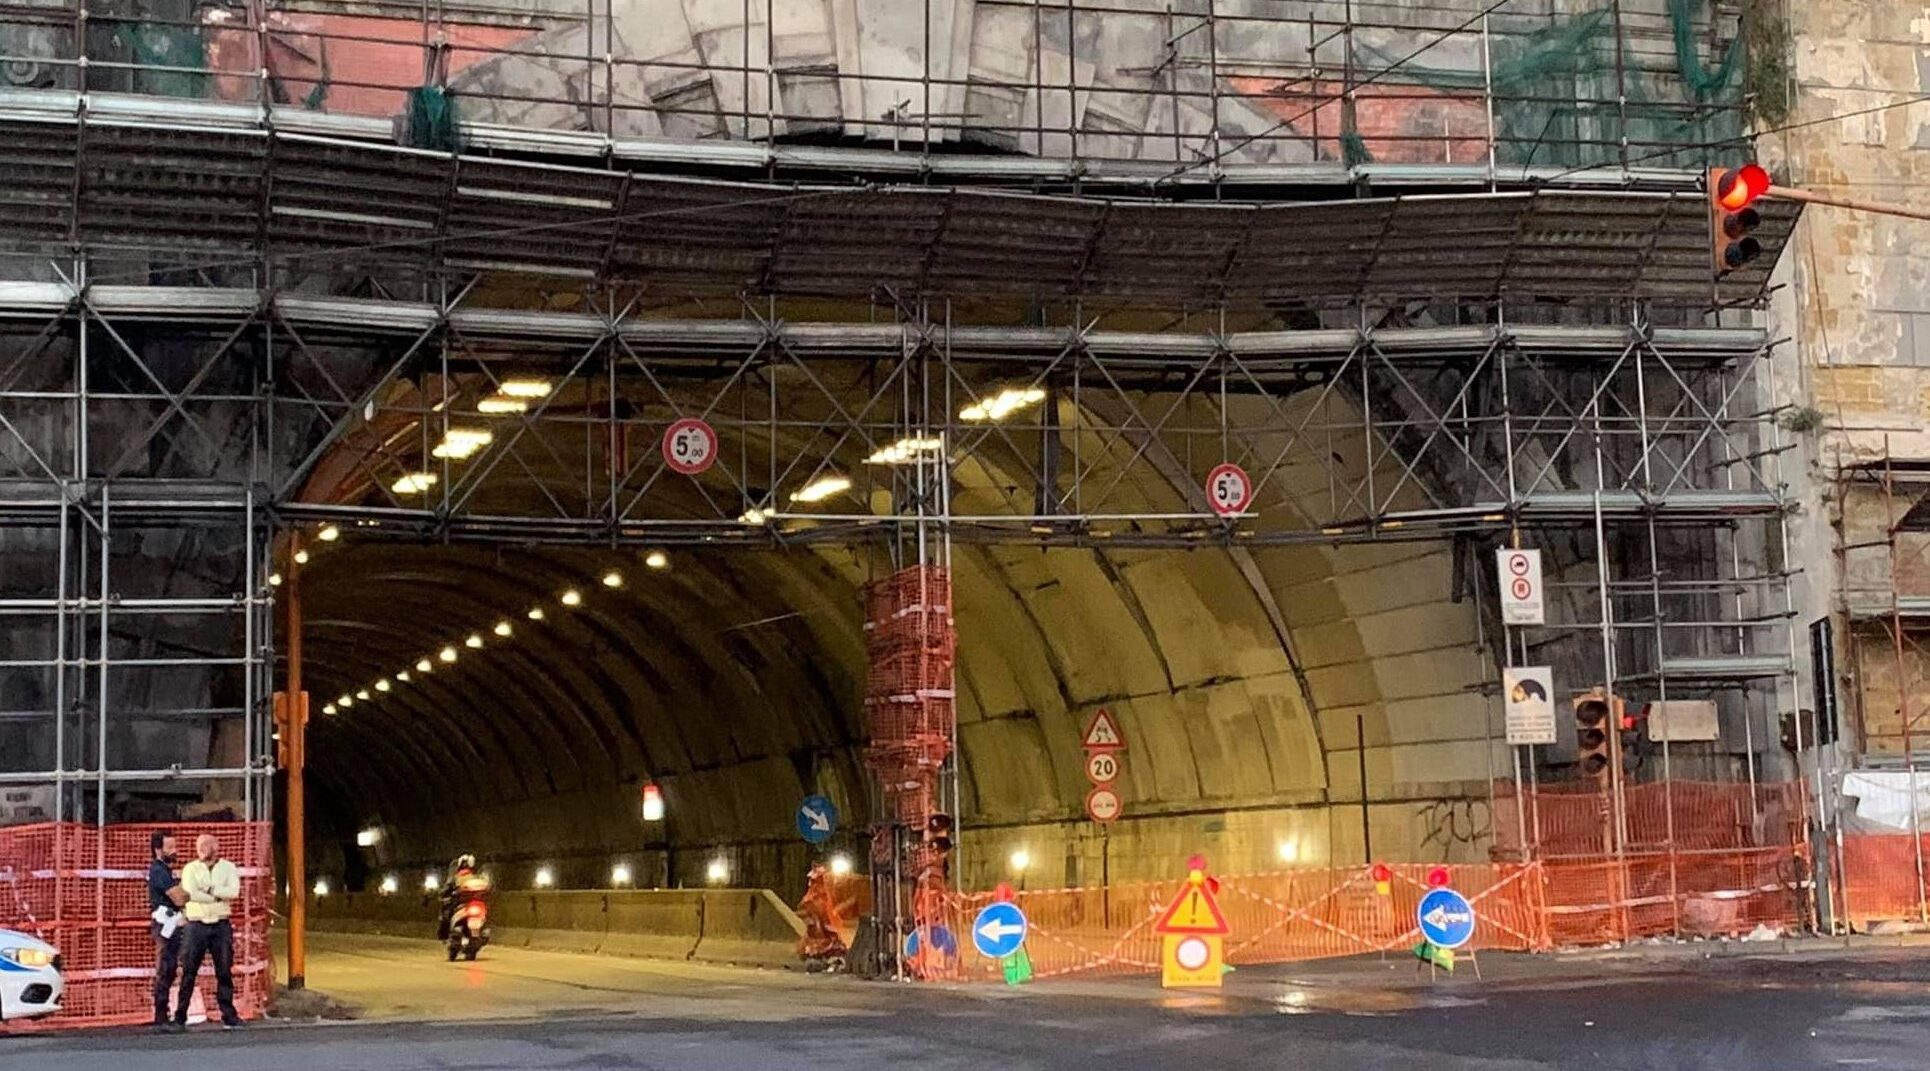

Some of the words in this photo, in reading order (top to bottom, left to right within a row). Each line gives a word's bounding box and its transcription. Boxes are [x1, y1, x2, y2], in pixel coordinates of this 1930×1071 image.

[676, 435, 688, 457] 5
[1217, 480, 1228, 501] 5
[1094, 760, 1114, 776] 20
